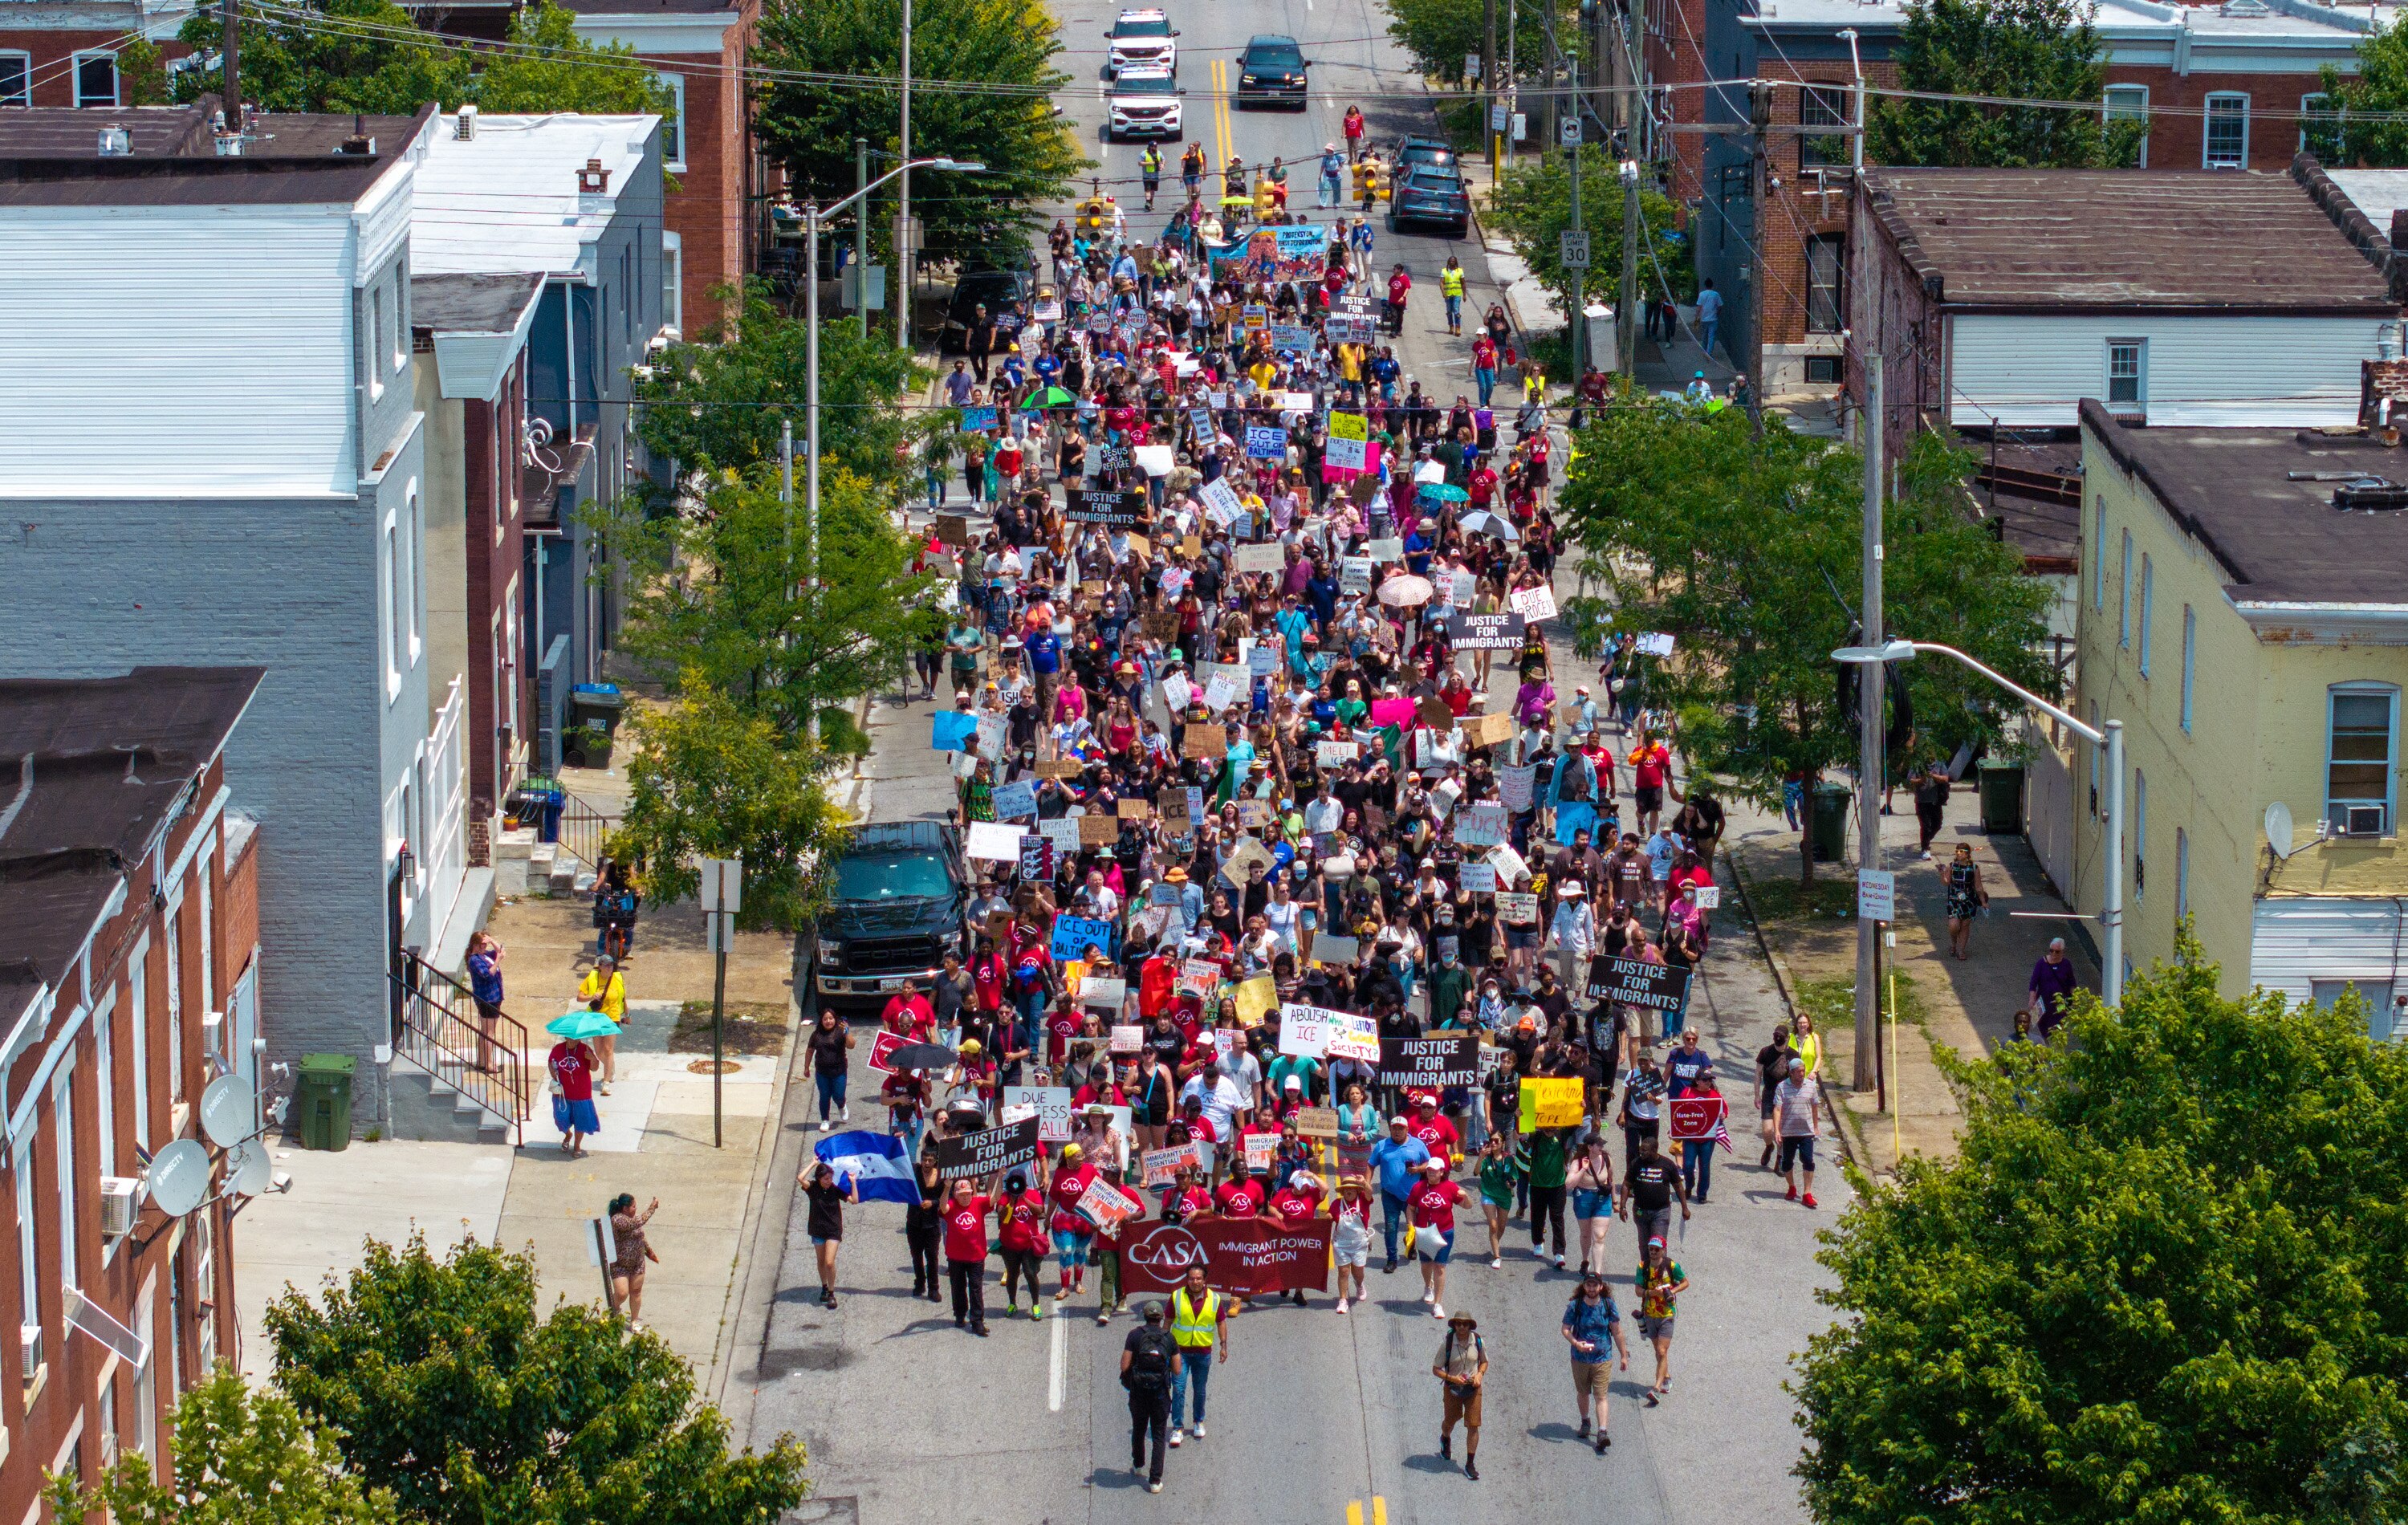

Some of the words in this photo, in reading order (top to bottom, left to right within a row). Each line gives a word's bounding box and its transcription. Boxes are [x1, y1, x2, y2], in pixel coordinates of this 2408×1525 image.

[1566, 249, 1584, 261] 30
[1340, 296, 1370, 306] JUSTICE
[1348, 305, 1363, 313] FOR
[1331, 312, 1381, 323] IMMIGRANTS
[1249, 429, 1283, 441] ICE
[1249, 439, 1271, 448] OUT
[1102, 446, 1129, 458] JESUS
[1248, 447, 1284, 457] BALTIMORE
[1103, 459, 1129, 471] REFUGEE
[1081, 492, 1122, 503] JUSTICE
[1092, 503, 1111, 513] FOR
[1068, 511, 1135, 524] IMMIGRANTS
[1520, 590, 1543, 605] DUE
[1516, 600, 1555, 620] PROCESS
[1465, 616, 1509, 627] JUSTICE
[1476, 626, 1499, 636] FOR
[1451, 636, 1524, 649] IMMIGRANTS
[1214, 672, 1239, 685] ABOLISH
[1217, 680, 1228, 689] ICE
[1324, 746, 1350, 756] MELT
[1331, 757, 1345, 766] ICE
[1163, 804, 1186, 819] ICE
[1043, 819, 1074, 832] RESPECT
[1458, 811, 1505, 837] FUCK
[1465, 828, 1487, 844] ICE
[1861, 882, 1890, 891] WEDNESDAY
[1498, 893, 1526, 901] Immigrants
[1698, 890, 1719, 898] DEPORT
[1703, 898, 1714, 906] ICE
[1084, 922, 1109, 939] OUT
[1072, 937, 1087, 946] OF
[1054, 942, 1085, 958] BALTIM
[1188, 962, 1213, 971] IMMIGRANTS
[1611, 960, 1669, 980] JUSTICE
[1091, 978, 1111, 988] ICE
[1622, 975, 1651, 991] FOR
[1290, 1008, 1328, 1023] ABOLISH
[1296, 1026, 1317, 1042] ICE
[1401, 1039, 1459, 1055] JUSTICE
[1416, 1056, 1444, 1071] FOR
[1381, 1070, 1474, 1087] IMMIGRANTS
[1023, 1092, 1046, 1103] DUE
[1534, 1112, 1568, 1124] TOPE!
[1039, 1121, 1071, 1137] ALL!
[962, 1124, 1019, 1149] JUSTICE
[1246, 1137, 1283, 1145] IMMIGRANTS
[976, 1142, 1005, 1161] FOR
[1145, 1151, 1183, 1168] IMMIGRANTS
[1183, 1148, 1195, 1157] ARE
[940, 1145, 1035, 1180] IMMIGRANTS
[1146, 1156, 1179, 1169] ESSENTIAL!
[1088, 1187, 1118, 1210] ESSENTIAL!
[1092, 1181, 1125, 1206] IMMIGRANTS
[1124, 1202, 1137, 1214] ARE
[1219, 1239, 1278, 1255] IMMIGRANT
[1279, 1238, 1322, 1250] POWER
[1128, 1241, 1210, 1266] CASA
[1243, 1255, 1255, 1267] IN
[1256, 1250, 1297, 1267] ACTION
